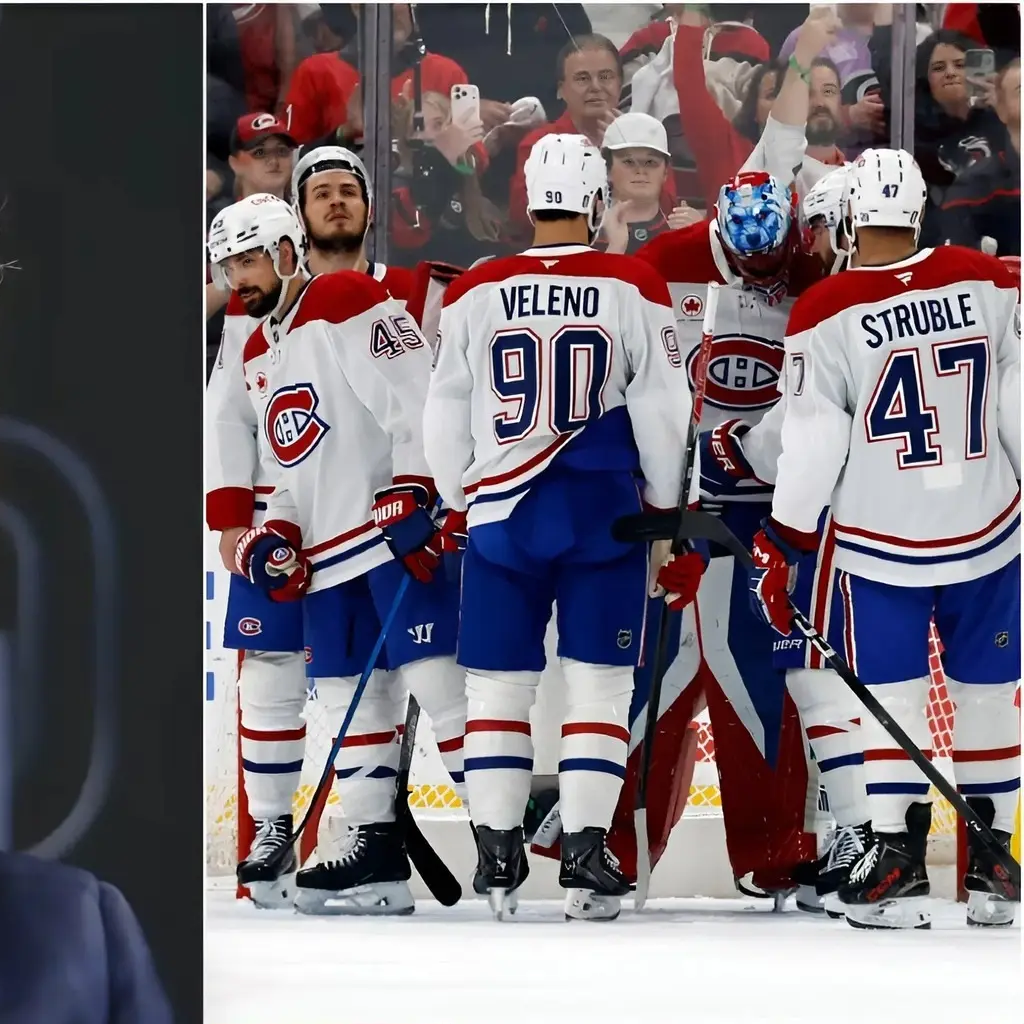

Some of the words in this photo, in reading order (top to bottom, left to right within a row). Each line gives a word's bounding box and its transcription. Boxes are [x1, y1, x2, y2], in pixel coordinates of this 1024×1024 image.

[545, 190, 563, 204] 90
[881, 183, 899, 198] 47
[500, 284, 600, 321] VELENO
[861, 293, 976, 349] STRUBLE
[370, 315, 425, 360] 45
[488, 324, 614, 446] 90
[864, 335, 991, 470] 47
